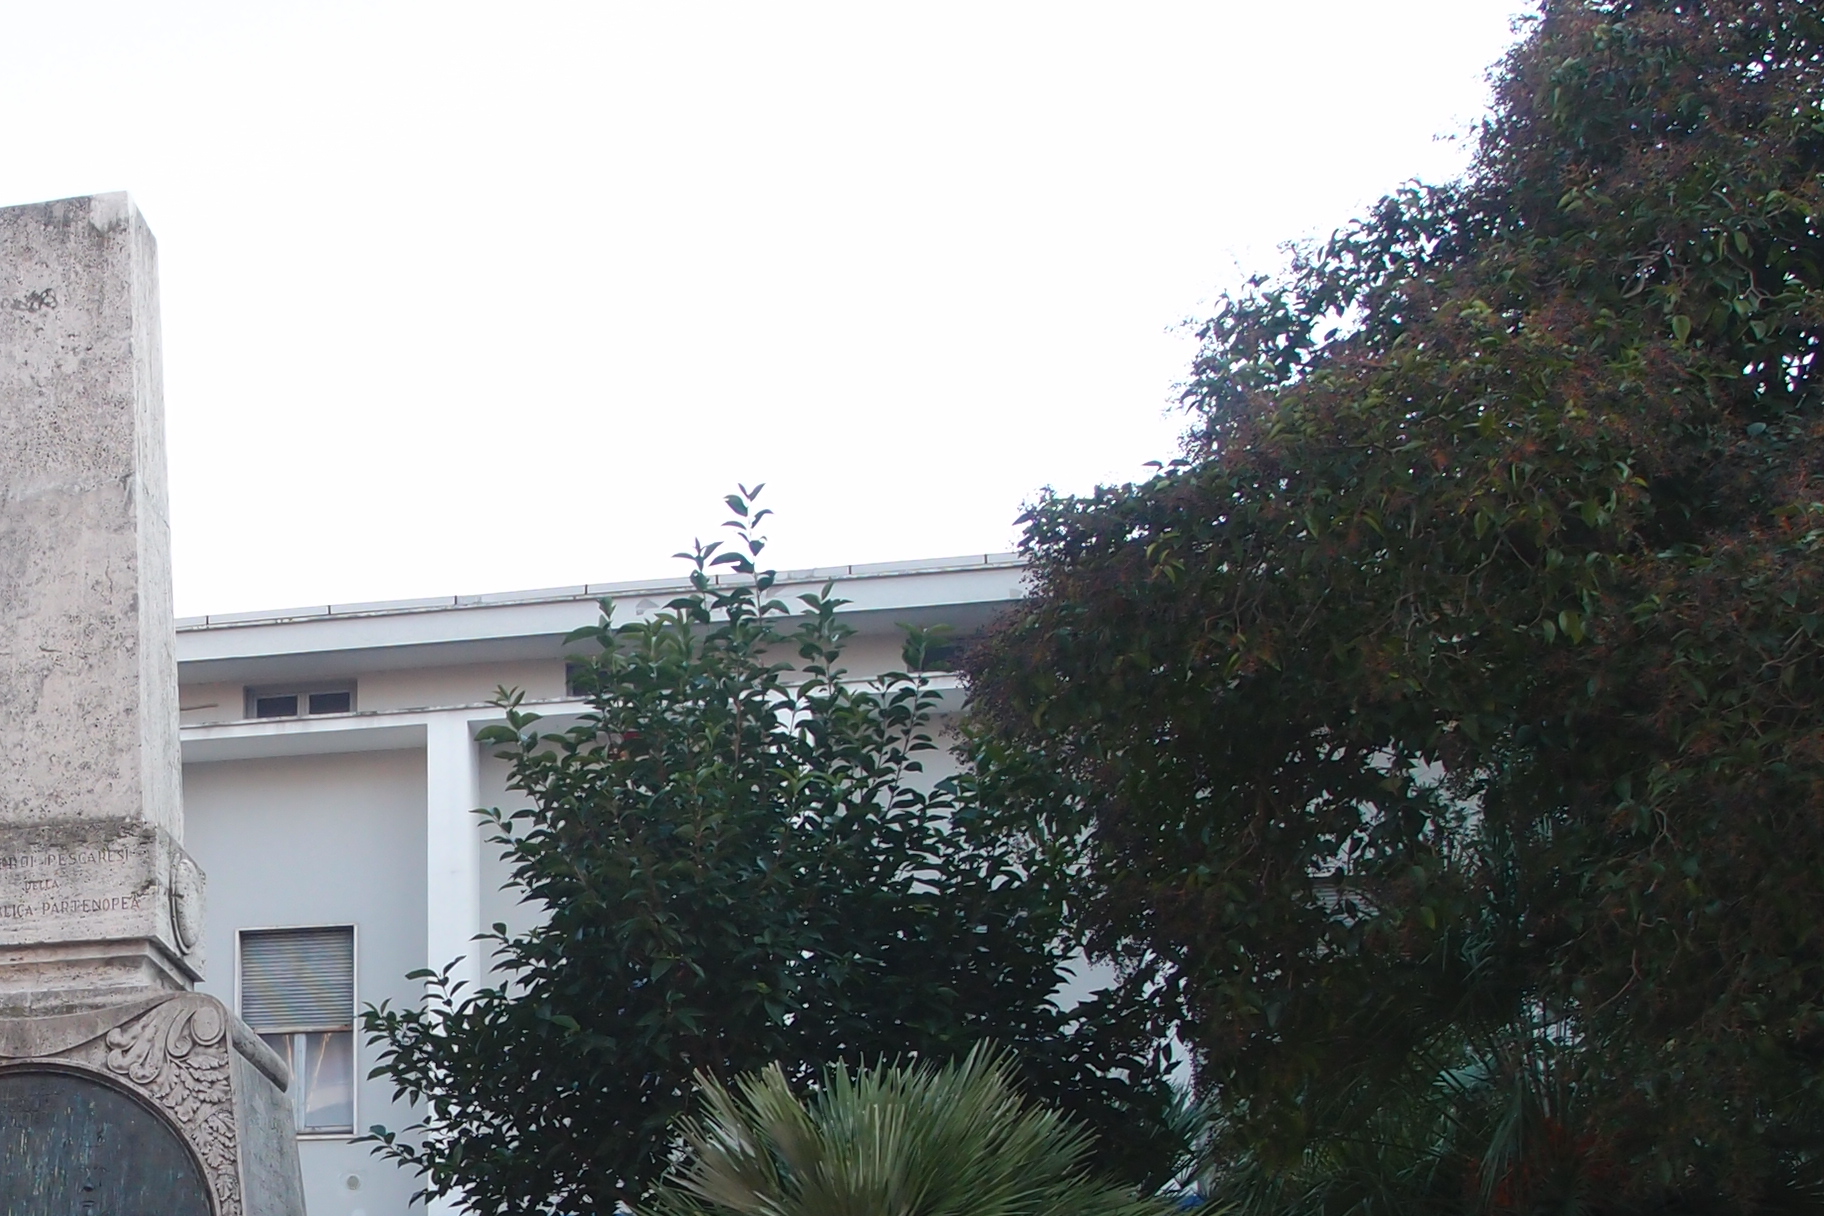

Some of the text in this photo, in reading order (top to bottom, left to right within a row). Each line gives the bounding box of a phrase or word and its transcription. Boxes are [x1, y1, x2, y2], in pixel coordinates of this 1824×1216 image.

[46, 850, 129, 866] PESCARESI
[25, 878, 60, 891] DELLA
[42, 896, 141, 915] PARTENOPEA
